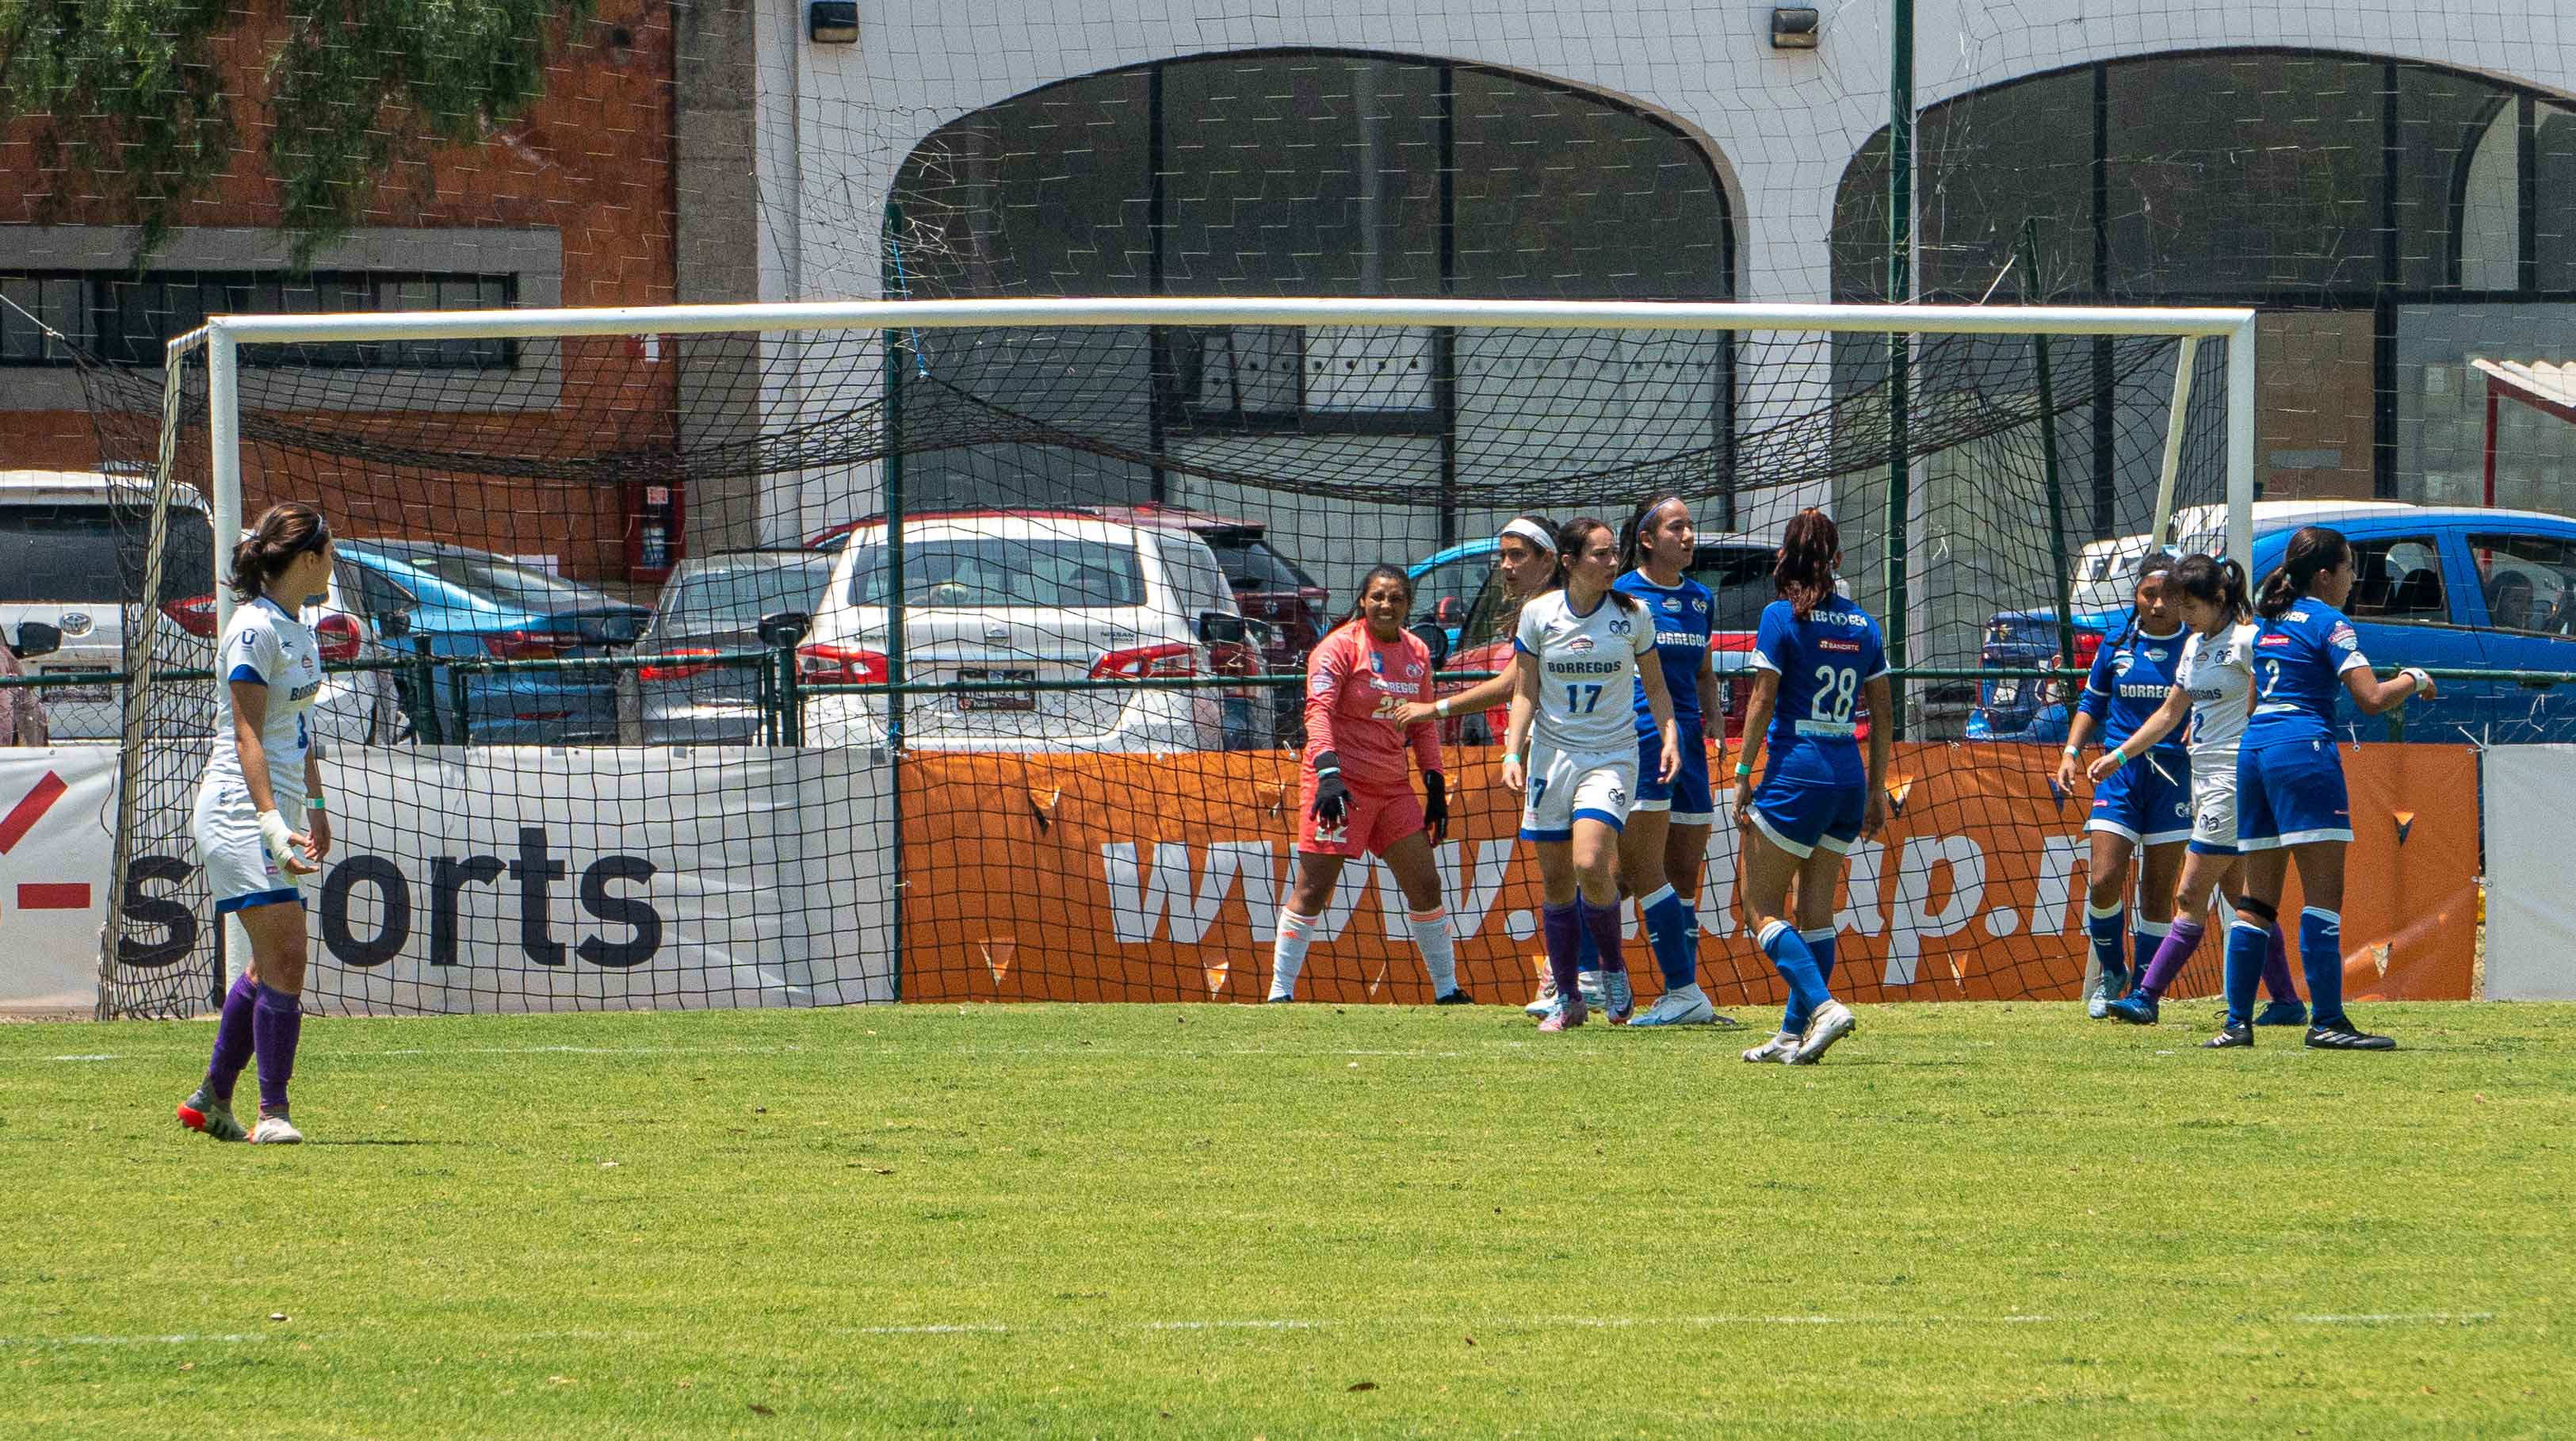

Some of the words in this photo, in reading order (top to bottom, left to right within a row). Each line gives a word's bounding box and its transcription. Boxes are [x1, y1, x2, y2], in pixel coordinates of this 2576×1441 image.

[1656, 632, 1707, 648] ORREGOS
[1546, 660, 1622, 674] BORREGOS
[1566, 684, 1603, 713] 17
[1812, 665, 1857, 724] 28
[2119, 684, 2172, 698] BORREG
[117, 827, 663, 1008] sorts
